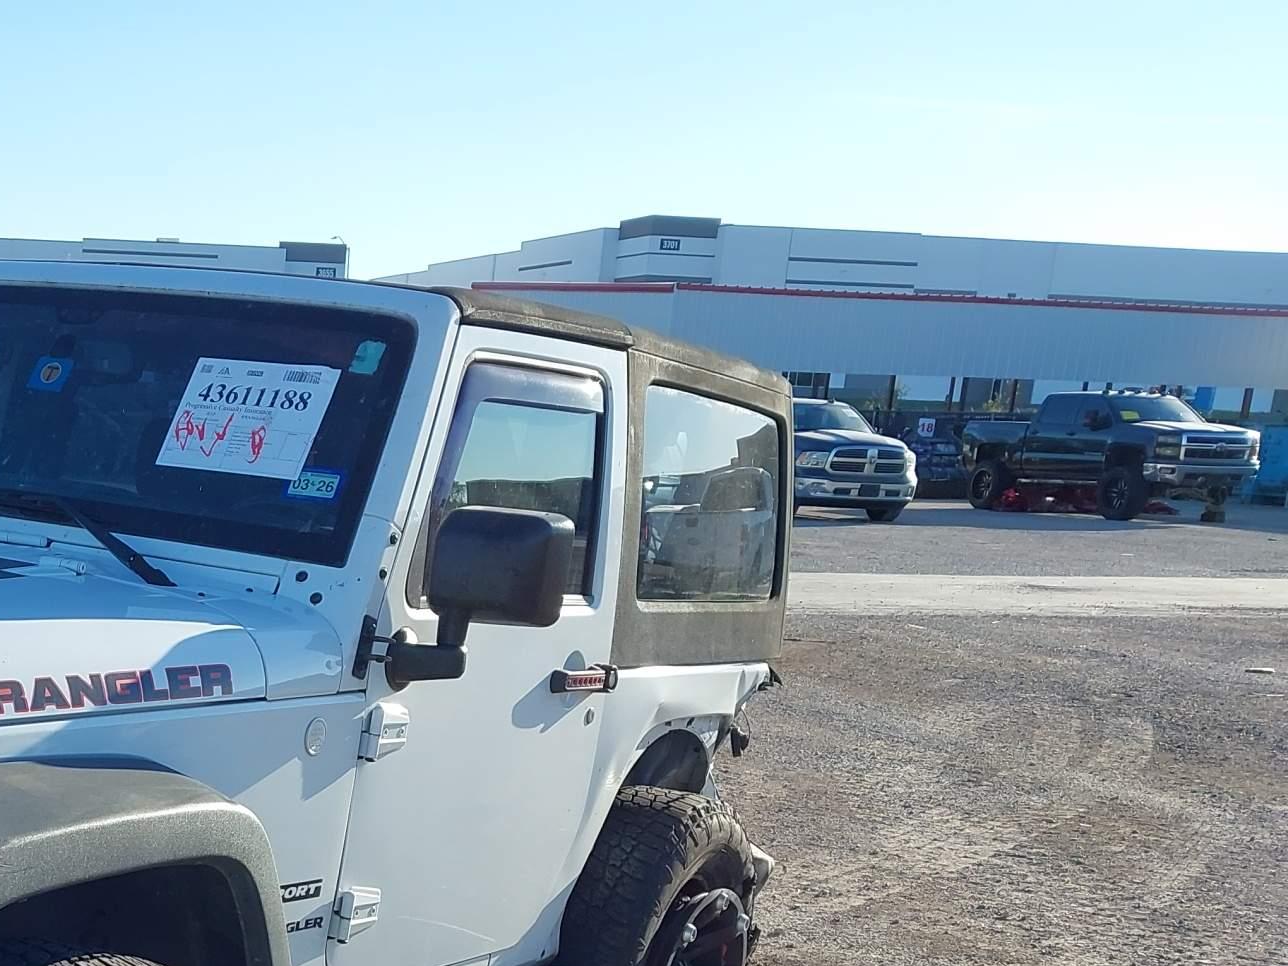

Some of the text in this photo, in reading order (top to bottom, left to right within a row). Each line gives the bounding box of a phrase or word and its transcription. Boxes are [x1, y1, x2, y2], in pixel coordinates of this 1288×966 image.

[198, 382, 313, 412] 43611188
[921, 422, 934, 433] 18
[292, 478, 335, 493] 03 26
